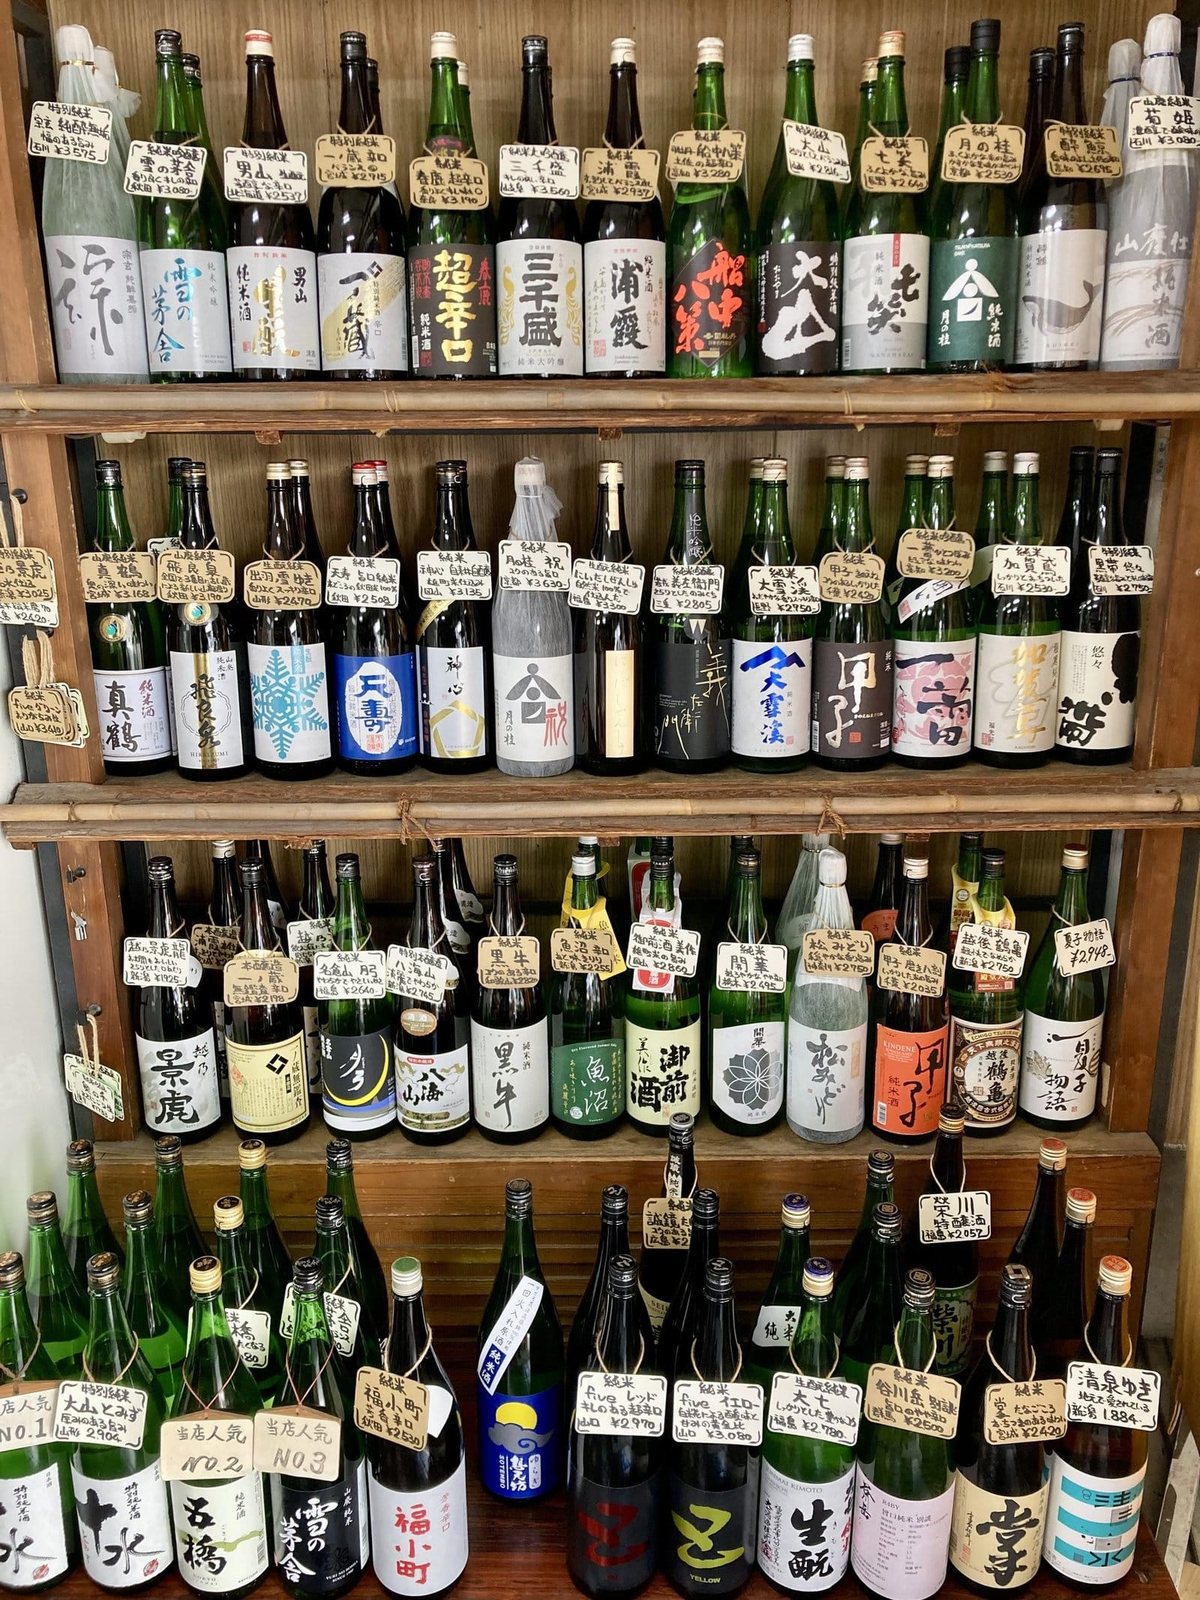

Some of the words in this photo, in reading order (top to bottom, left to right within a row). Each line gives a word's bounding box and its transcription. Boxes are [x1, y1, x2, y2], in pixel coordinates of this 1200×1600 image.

[960, 138, 1014, 154] 月の桂
[237, 161, 272, 180] 男山
[874, 252, 883, 286] 純米酒
[237, 264, 251, 321] 純米酒
[293, 266, 308, 303] 男山
[433, 249, 477, 363] 超辛口
[519, 252, 562, 348] 三千盛
[610, 258, 647, 349] 浦霞
[762, 251, 836, 360] 大山
[420, 313, 431, 349] 純米酒
[938, 309, 950, 346] 月の桂
[518, 358, 565, 366] 純米大吟醸
[520, 542, 548, 553] 純米
[1015, 547, 1044, 557] 純米
[353, 559, 375, 568] 純米
[439, 553, 467, 564] 純米
[769, 567, 798, 579] 純米
[677, 600, 712, 610] ¥2805
[1092, 645, 1104, 669] 悠々
[446, 655, 463, 696] 神心
[140, 681, 154, 717] 純米酒
[760, 672, 787, 744] 大雪渓
[102, 682, 141, 752] 真鶴
[504, 711, 516, 746] 月の桂
[574, 930, 597, 940] 純米
[653, 928, 678, 937] 純米
[827, 931, 852, 940] 純米
[981, 926, 1003, 936] 純米
[1064, 929, 1105, 949] 夏子物語
[499, 938, 521, 947] 純米
[560, 941, 588, 953] 魚沼
[740, 946, 765, 955] 純米
[337, 953, 362, 962] 純米
[491, 949, 530, 967] 黒牛
[396, 961, 436, 979] 八海山
[255, 995, 285, 1003] ¥2198
[884, 1040, 915, 1053] KINOENE
[971, 1033, 992, 1041] ECHIGO
[151, 1049, 199, 1124] 景虎
[492, 1041, 518, 1128] 黒牛
[581, 1056, 610, 1115] 魚沼
[888, 1076, 899, 1106] 純米酒
[900, 1040, 943, 1127] 甲子
[482, 1350, 501, 1384] 純米酒
[604, 1375, 633, 1387] 純米
[699, 1383, 729, 1395] 純米
[893, 1369, 929, 1390] 純米
[1015, 1383, 1044, 1396] 純米
[365, 1384, 423, 1421] 福小町
[585, 1387, 616, 1403] five
[679, 1394, 709, 1409] five
[793, 1391, 829, 1410] 大七
[876, 1381, 924, 1407] 谷川岳
[64, 1395, 97, 1415] 大山
[177, 1423, 246, 1443] 当店人気
[267, 1418, 332, 1444] 当店人気
[274, 1449, 327, 1474] NO.3
[296, 1498, 338, 1552] 雪の
[395, 1504, 431, 1585] 福小町
[689, 1573, 721, 1583] YELLOW
